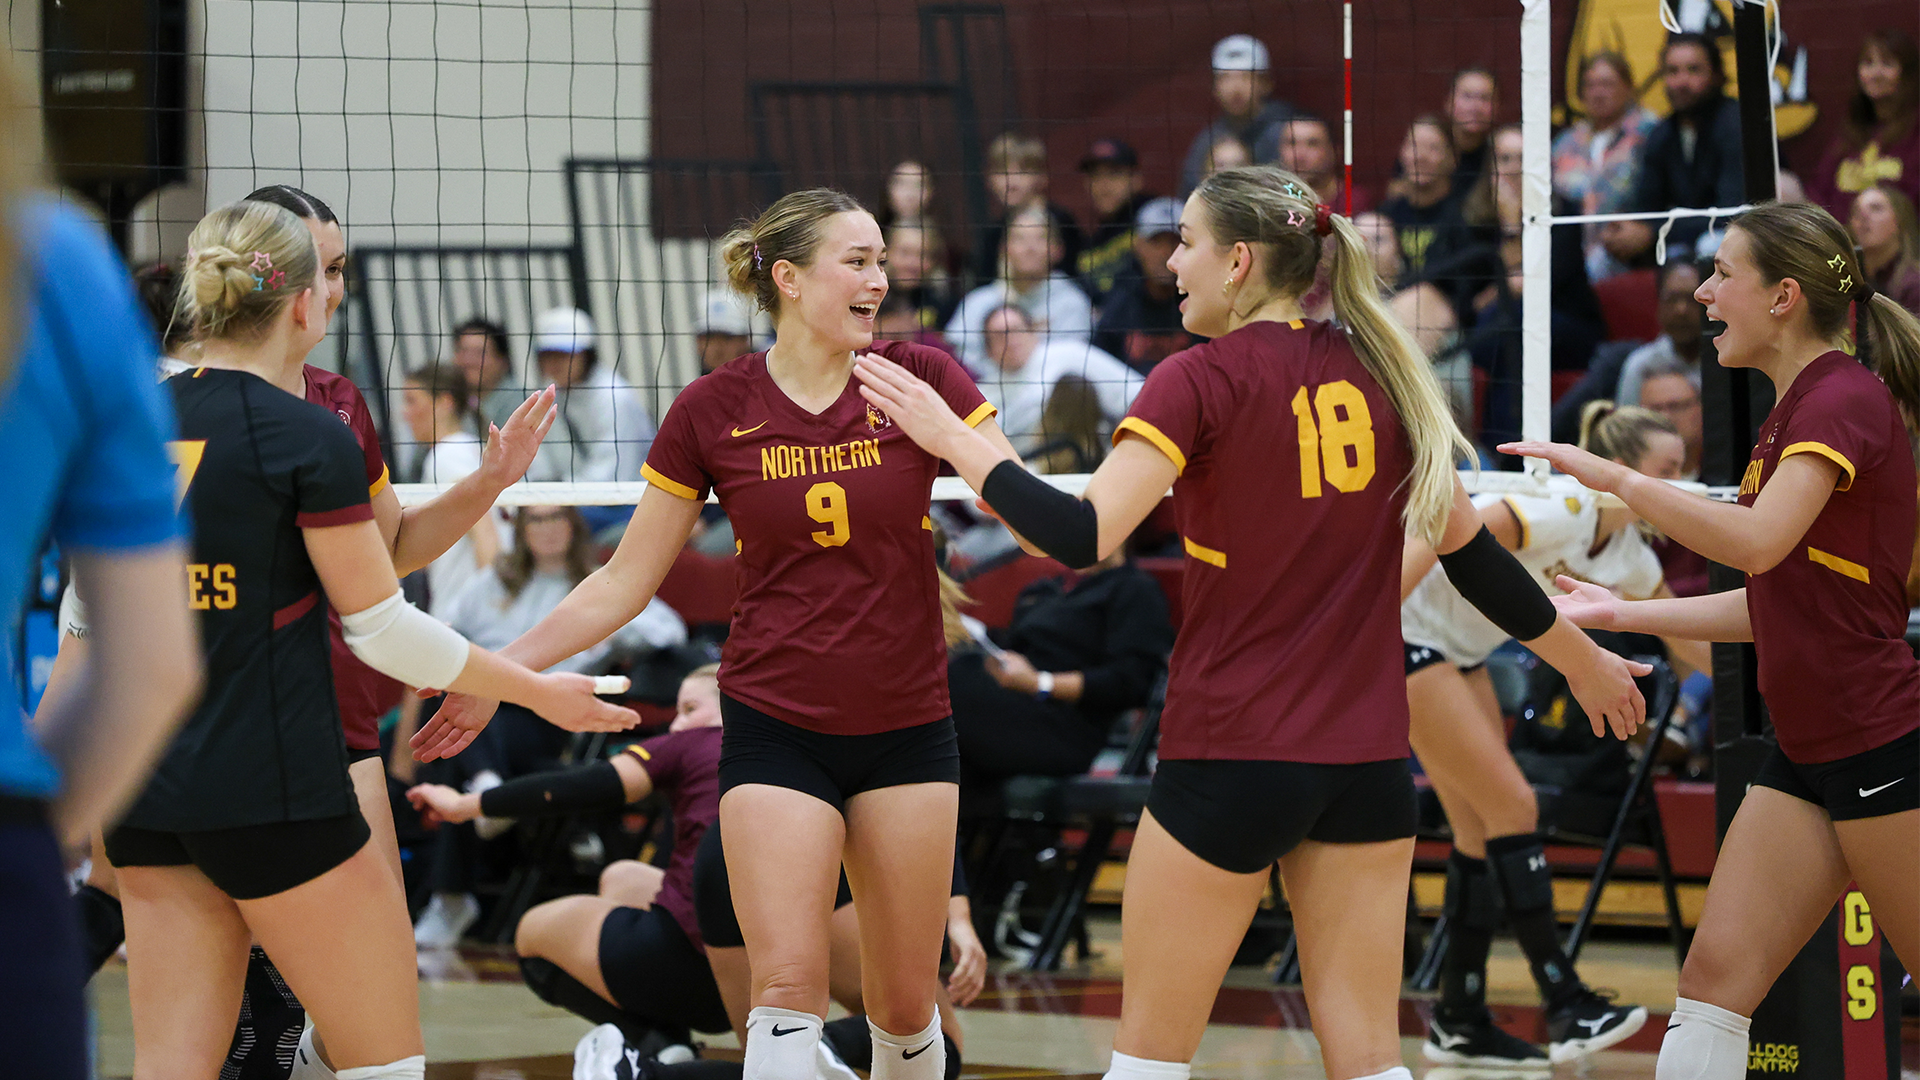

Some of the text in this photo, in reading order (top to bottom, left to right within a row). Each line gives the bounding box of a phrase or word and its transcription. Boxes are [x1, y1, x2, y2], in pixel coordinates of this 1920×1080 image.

[761, 438, 882, 481] NORTHERN
[1291, 379, 1376, 499] 18
[805, 481, 851, 548] 9
